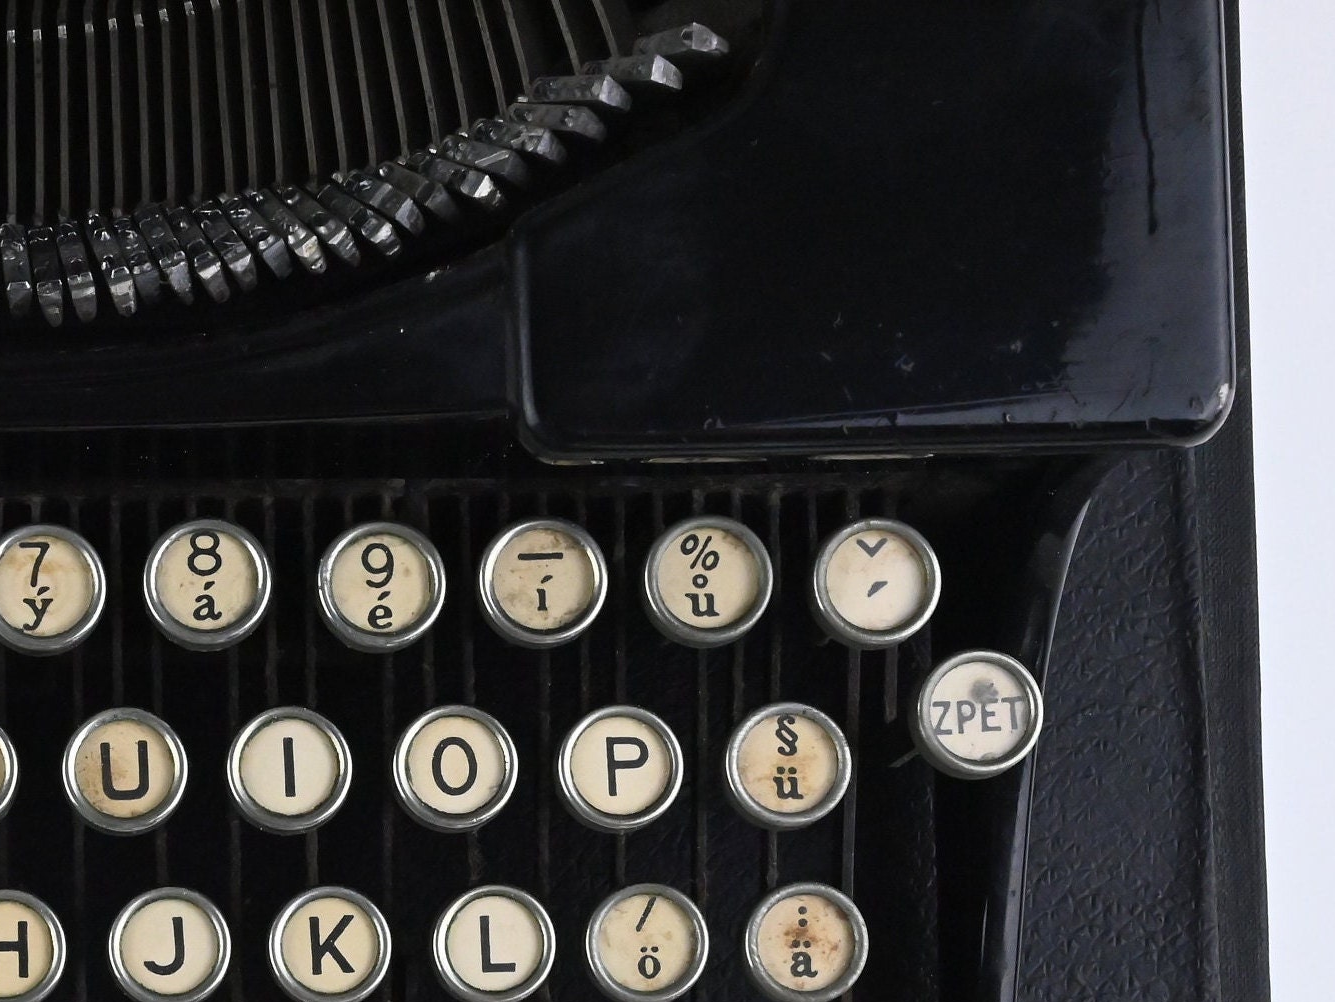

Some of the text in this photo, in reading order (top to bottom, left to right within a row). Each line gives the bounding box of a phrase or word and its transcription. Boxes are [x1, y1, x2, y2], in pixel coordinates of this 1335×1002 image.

[19, 541, 50, 588] 7
[187, 532, 222, 577] 8
[360, 542, 394, 589] 9
[680, 534, 720, 571] %
[22, 585, 54, 631] ý
[192, 580, 222, 621] á
[367, 590, 393, 629] é
[536, 574, 553, 612] í
[684, 573, 720, 618] ů
[775, 714, 800, 757] §
[99, 739, 150, 801] U
[282, 737, 297, 798] I
[431, 736, 478, 796] O
[605, 736, 649, 797] P
[772, 766, 805, 801] ü
[143, 916, 185, 976] J
[308, 914, 356, 976] K
[479, 915, 517, 973] L
[637, 946, 662, 980] ö
[790, 938, 819, 979] ä
